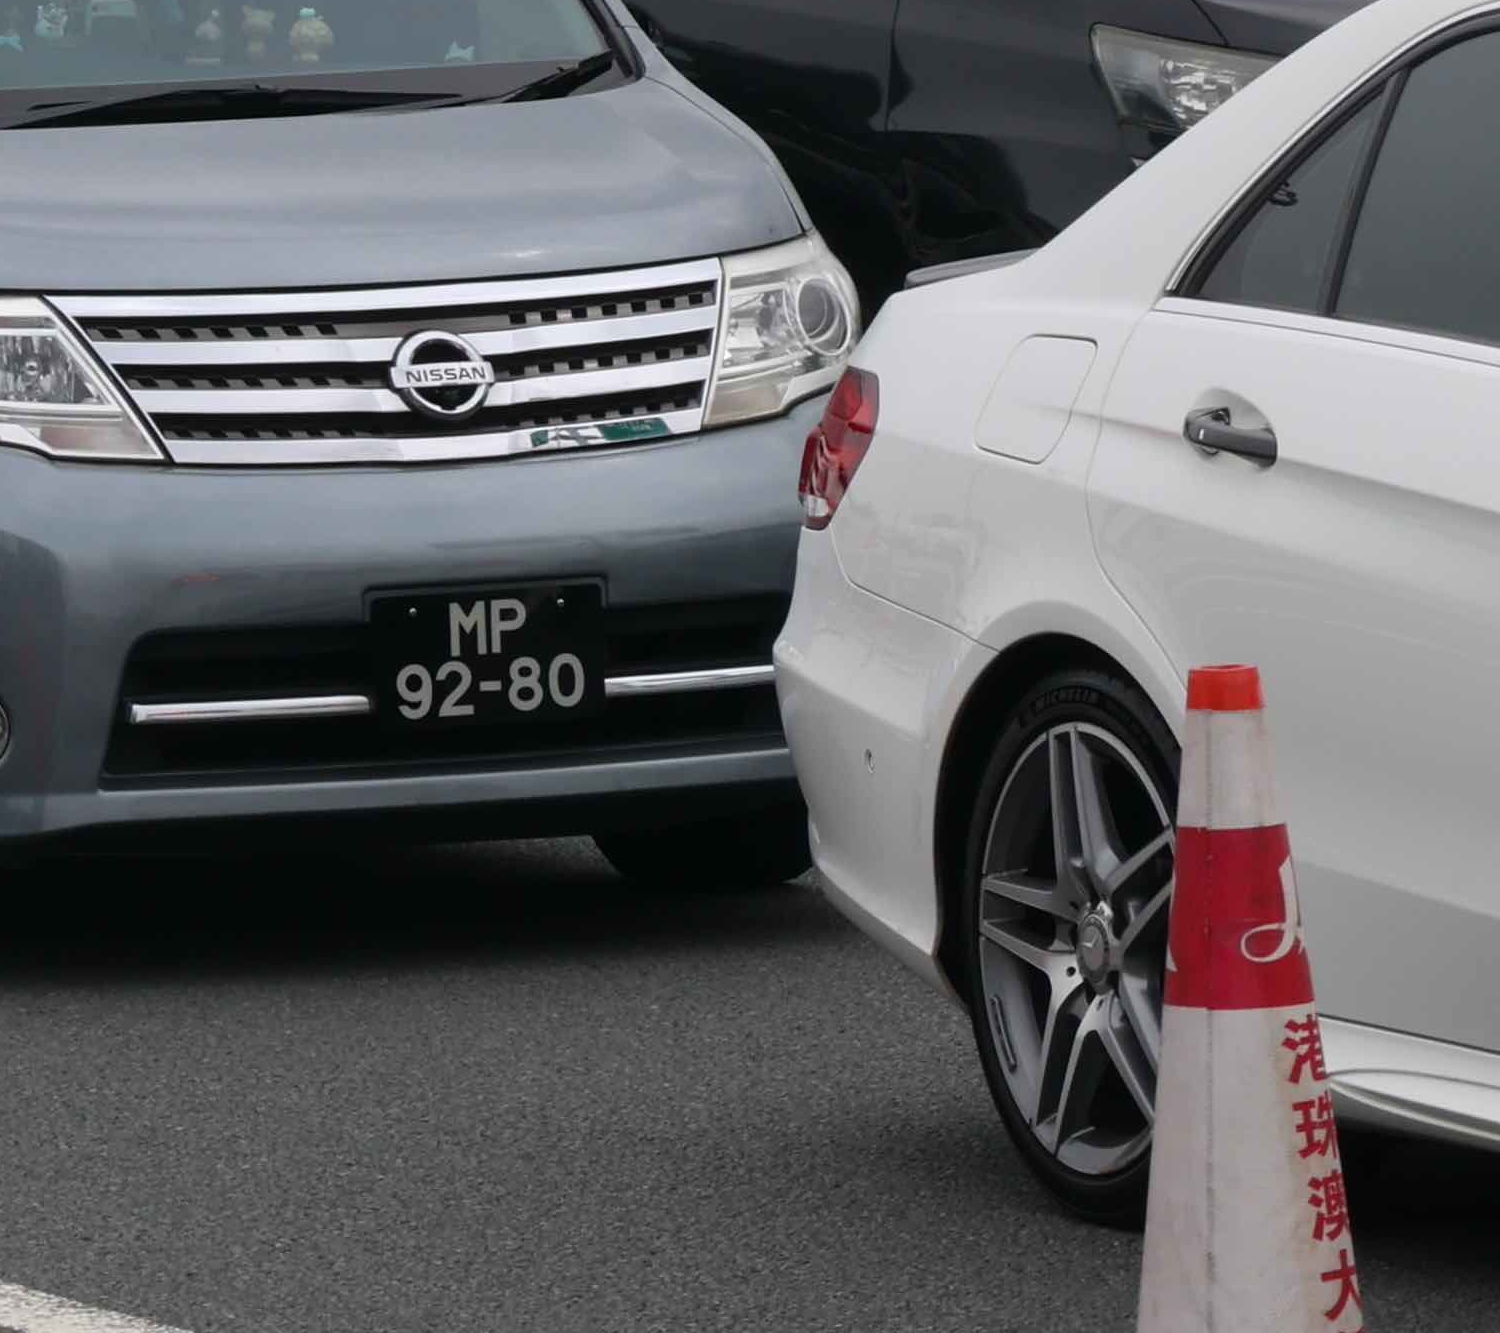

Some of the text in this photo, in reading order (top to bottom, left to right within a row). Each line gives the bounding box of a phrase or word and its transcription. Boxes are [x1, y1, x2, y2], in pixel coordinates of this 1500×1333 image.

[405, 366, 488, 385] NISSAN
[448, 598, 527, 658] MP
[396, 652, 586, 720] 92-80
